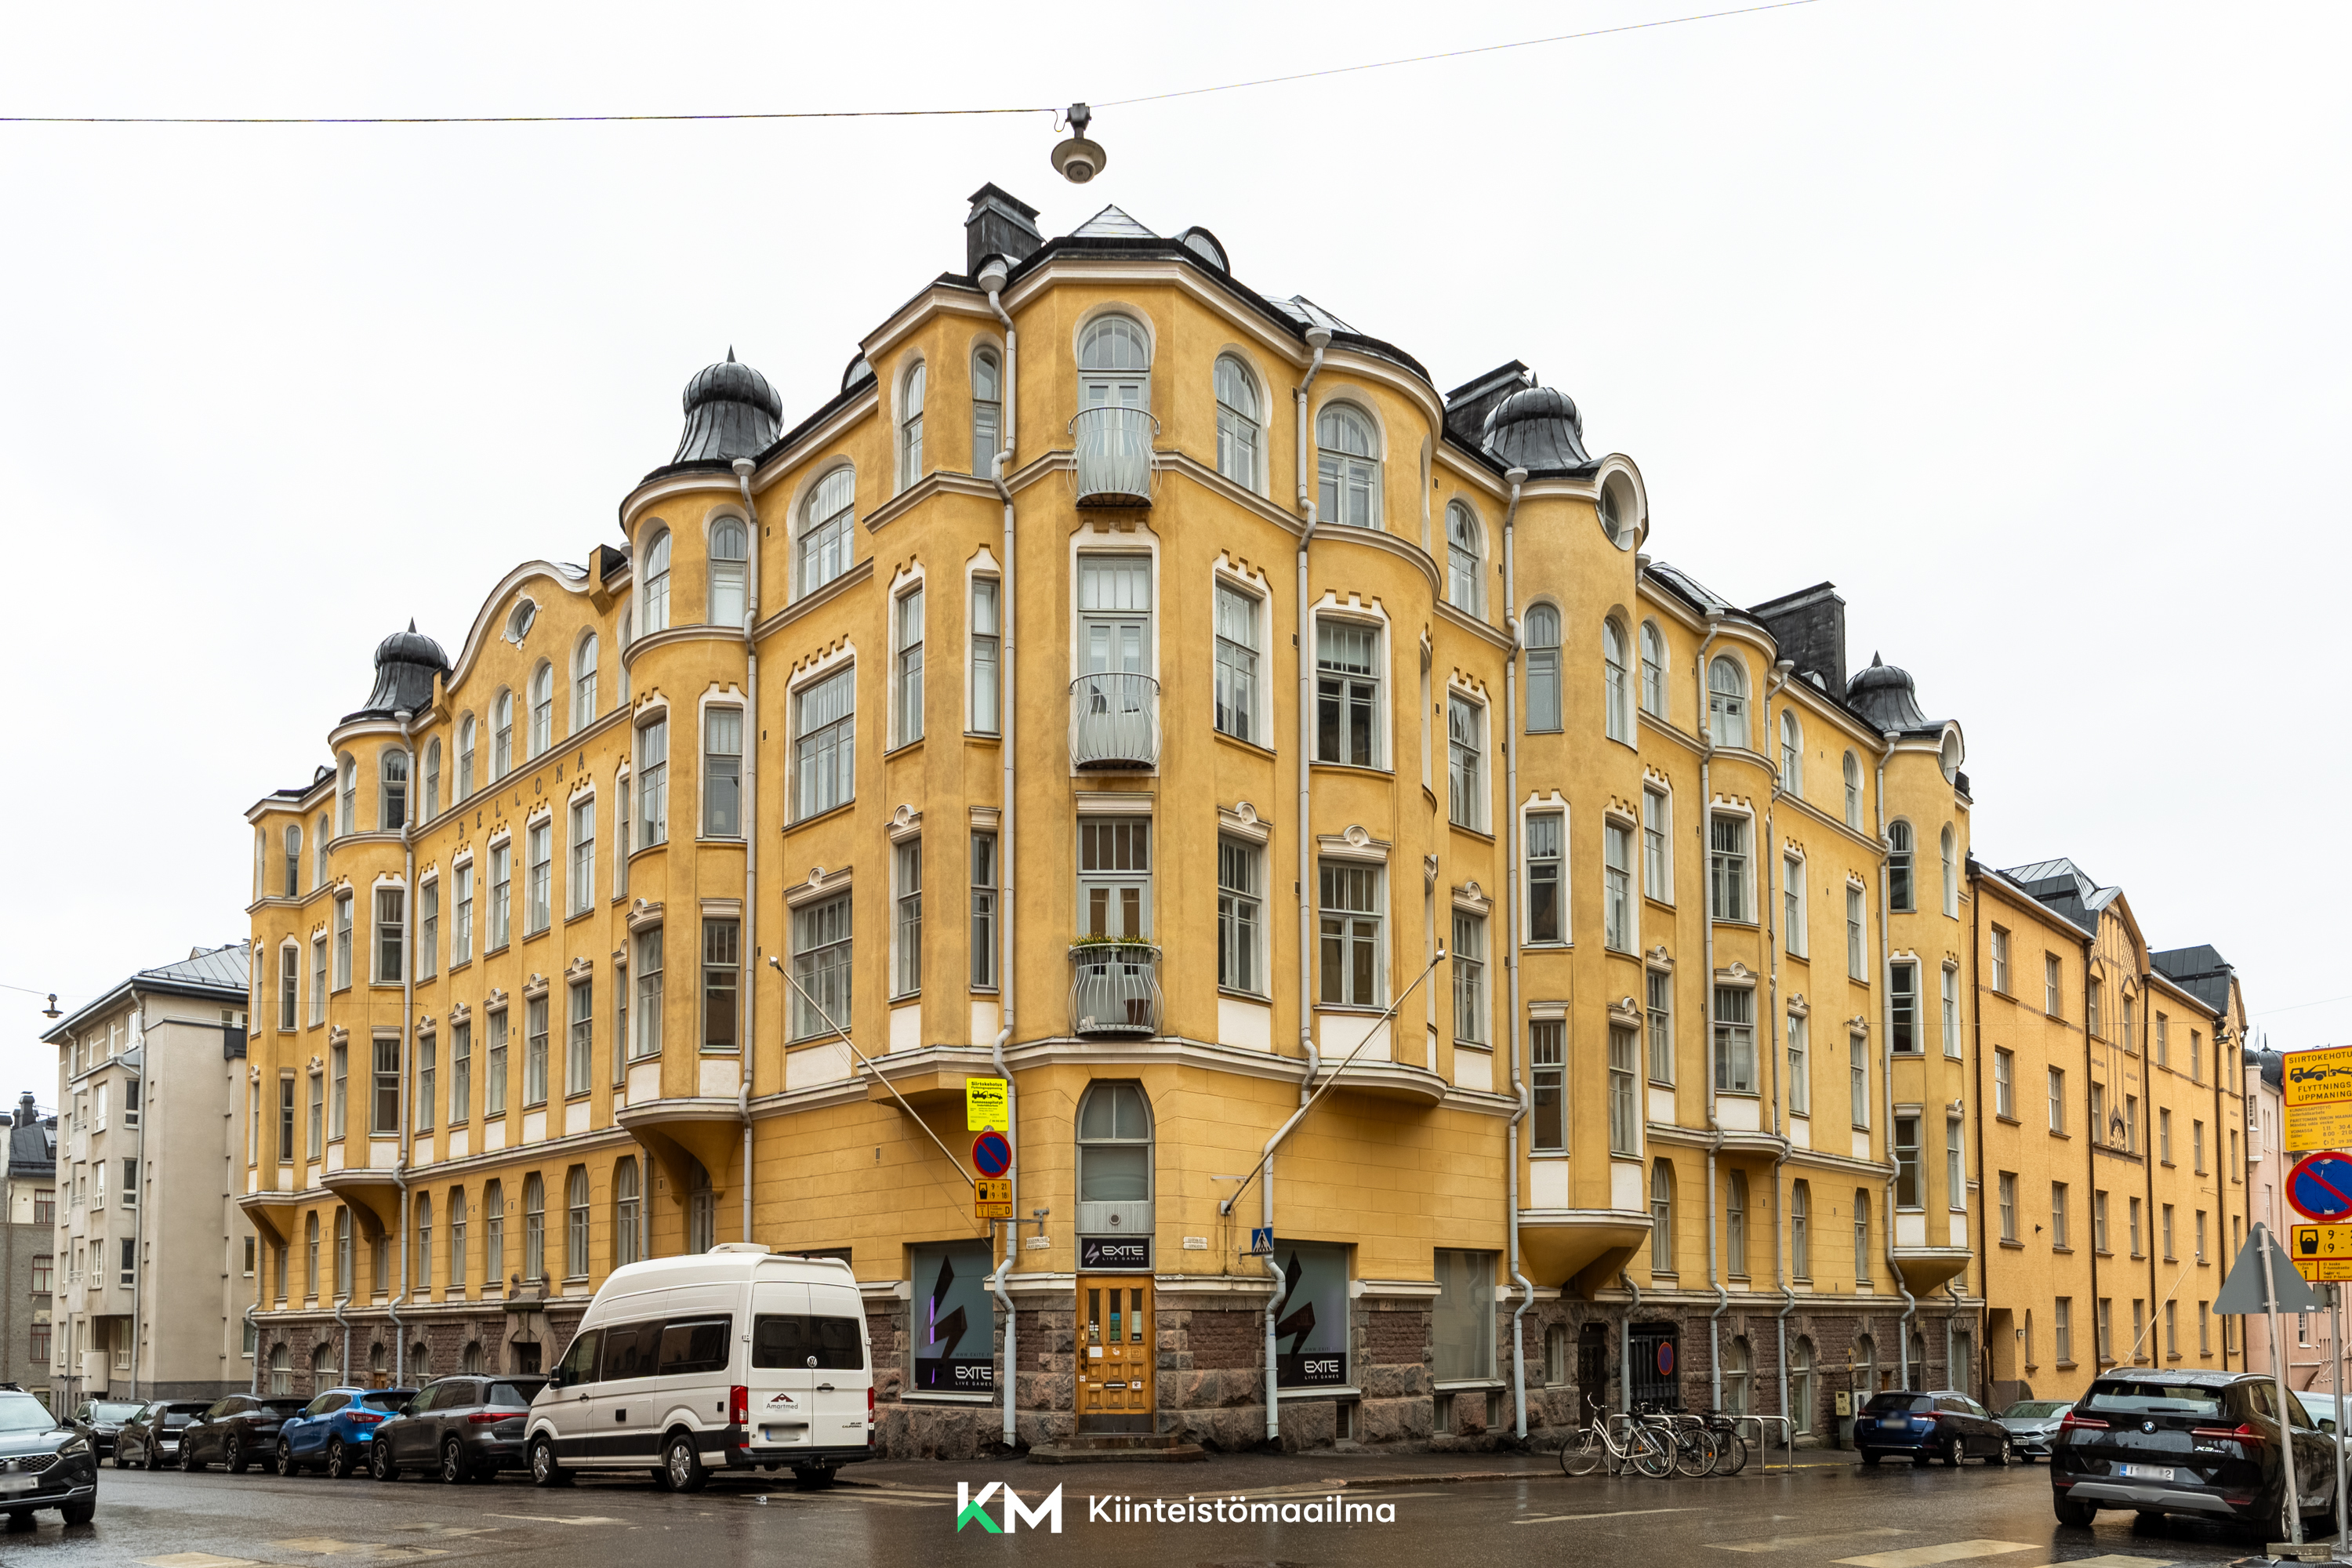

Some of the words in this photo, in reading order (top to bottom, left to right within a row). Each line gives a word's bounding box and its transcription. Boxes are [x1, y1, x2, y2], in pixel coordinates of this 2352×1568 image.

[458, 751, 585, 840] BELLONA
[2298, 1091, 2352, 1102] UPPMANING
[1004, 1206, 1011, 1215] D
[1102, 1246, 1144, 1256] EXITE
[2303, 1269, 2307, 1279] 1
[1305, 1359, 1338, 1373] EXITE
[956, 1366, 992, 1380] EXITE
